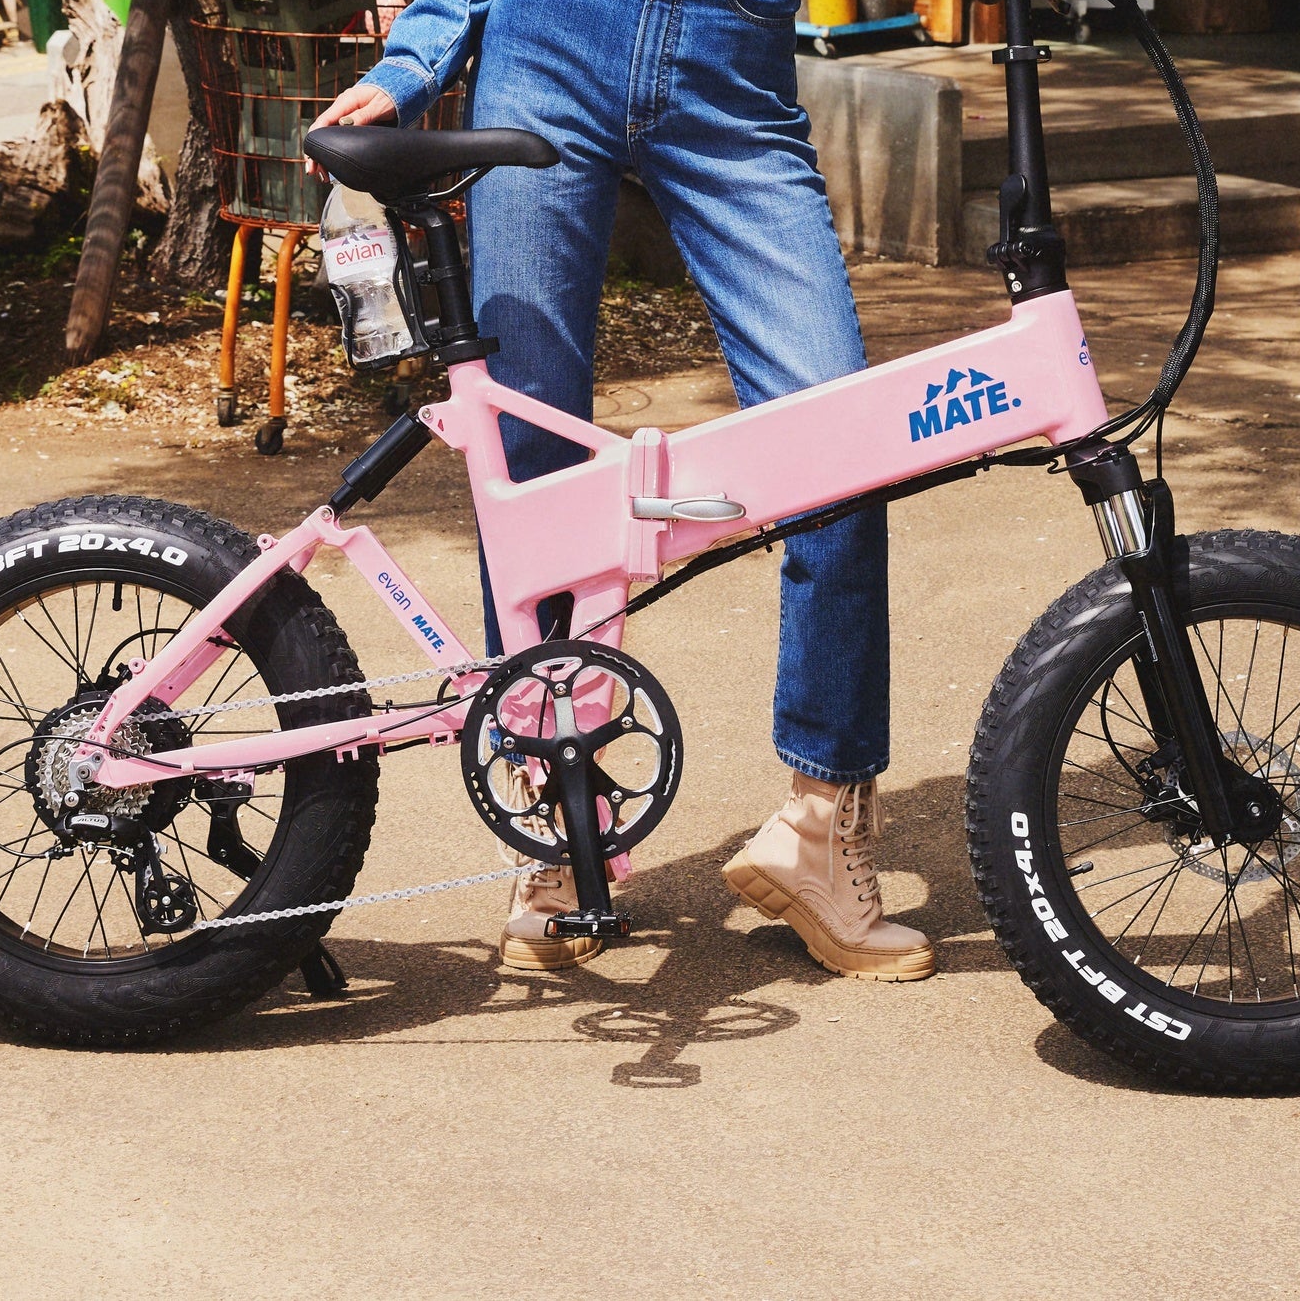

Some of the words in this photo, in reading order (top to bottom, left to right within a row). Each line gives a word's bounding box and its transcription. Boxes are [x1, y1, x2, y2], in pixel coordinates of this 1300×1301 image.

[336, 242, 384, 266] evian
[908, 381, 1022, 443] MATE.
[58, 533, 189, 567] 20x4.0
[377, 571, 412, 611] evian
[411, 614, 445, 653] MATE.
[1011, 811, 1070, 943] 20x4.0
[1061, 949, 1127, 1004] BFT
[1124, 1002, 1193, 1041] CST
